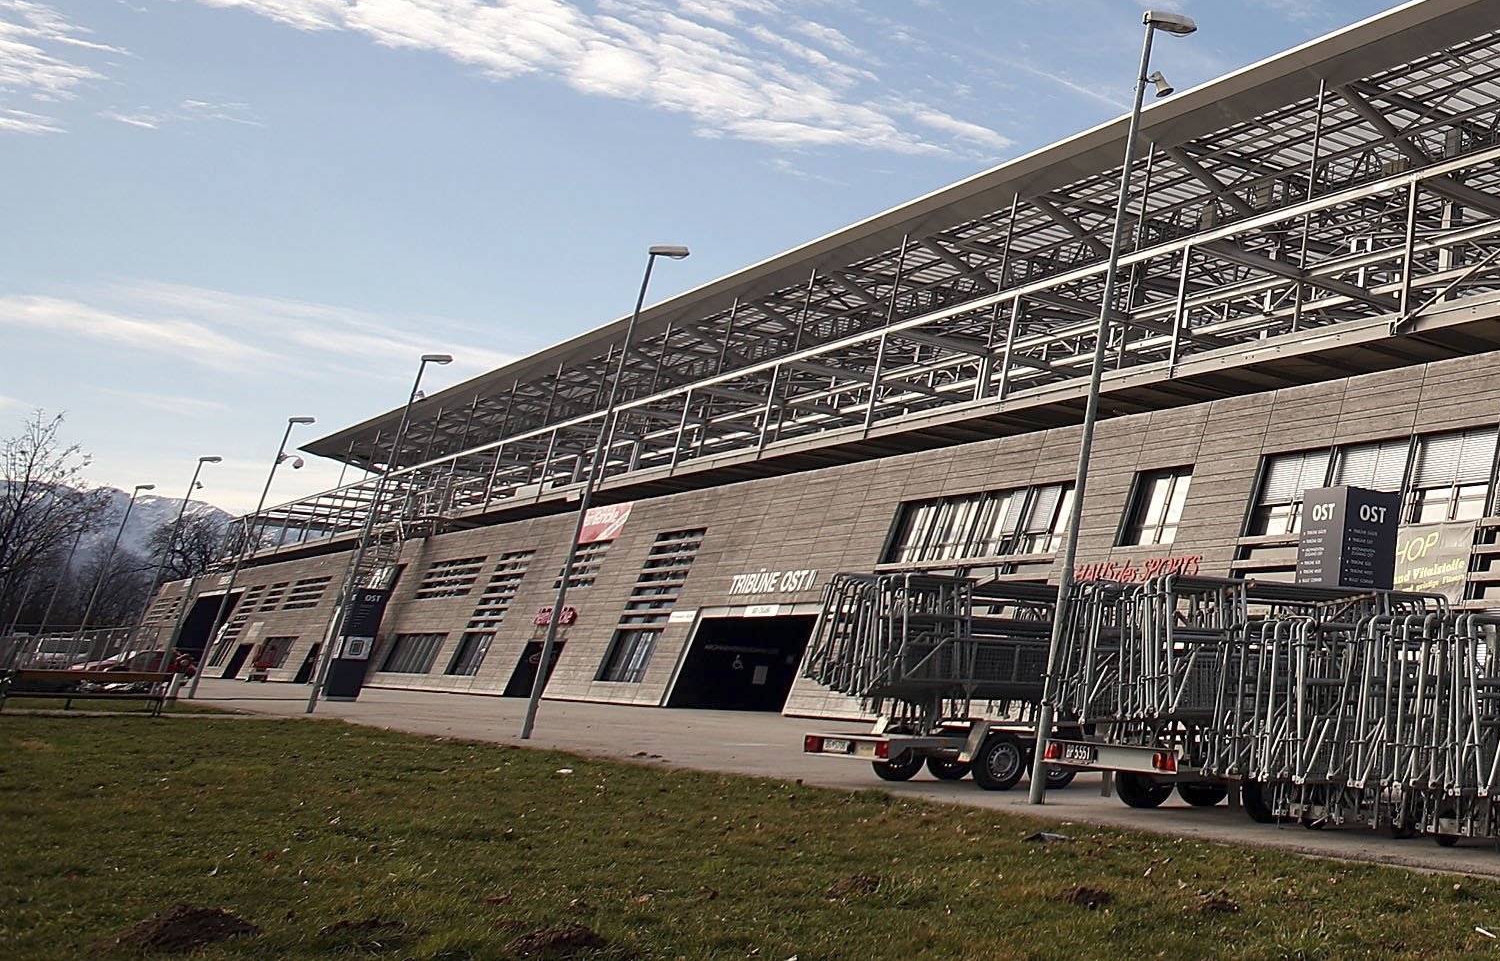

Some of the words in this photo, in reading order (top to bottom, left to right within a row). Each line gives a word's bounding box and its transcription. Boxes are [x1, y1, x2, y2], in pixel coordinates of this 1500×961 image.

[1312, 503, 1336, 522] OST
[1359, 504, 1387, 524] OST
[1140, 555, 1203, 582] SPORTS
[728, 567, 781, 595] TRIBÜNE
[780, 569, 810, 593] OST
[364, 594, 382, 603] OST
